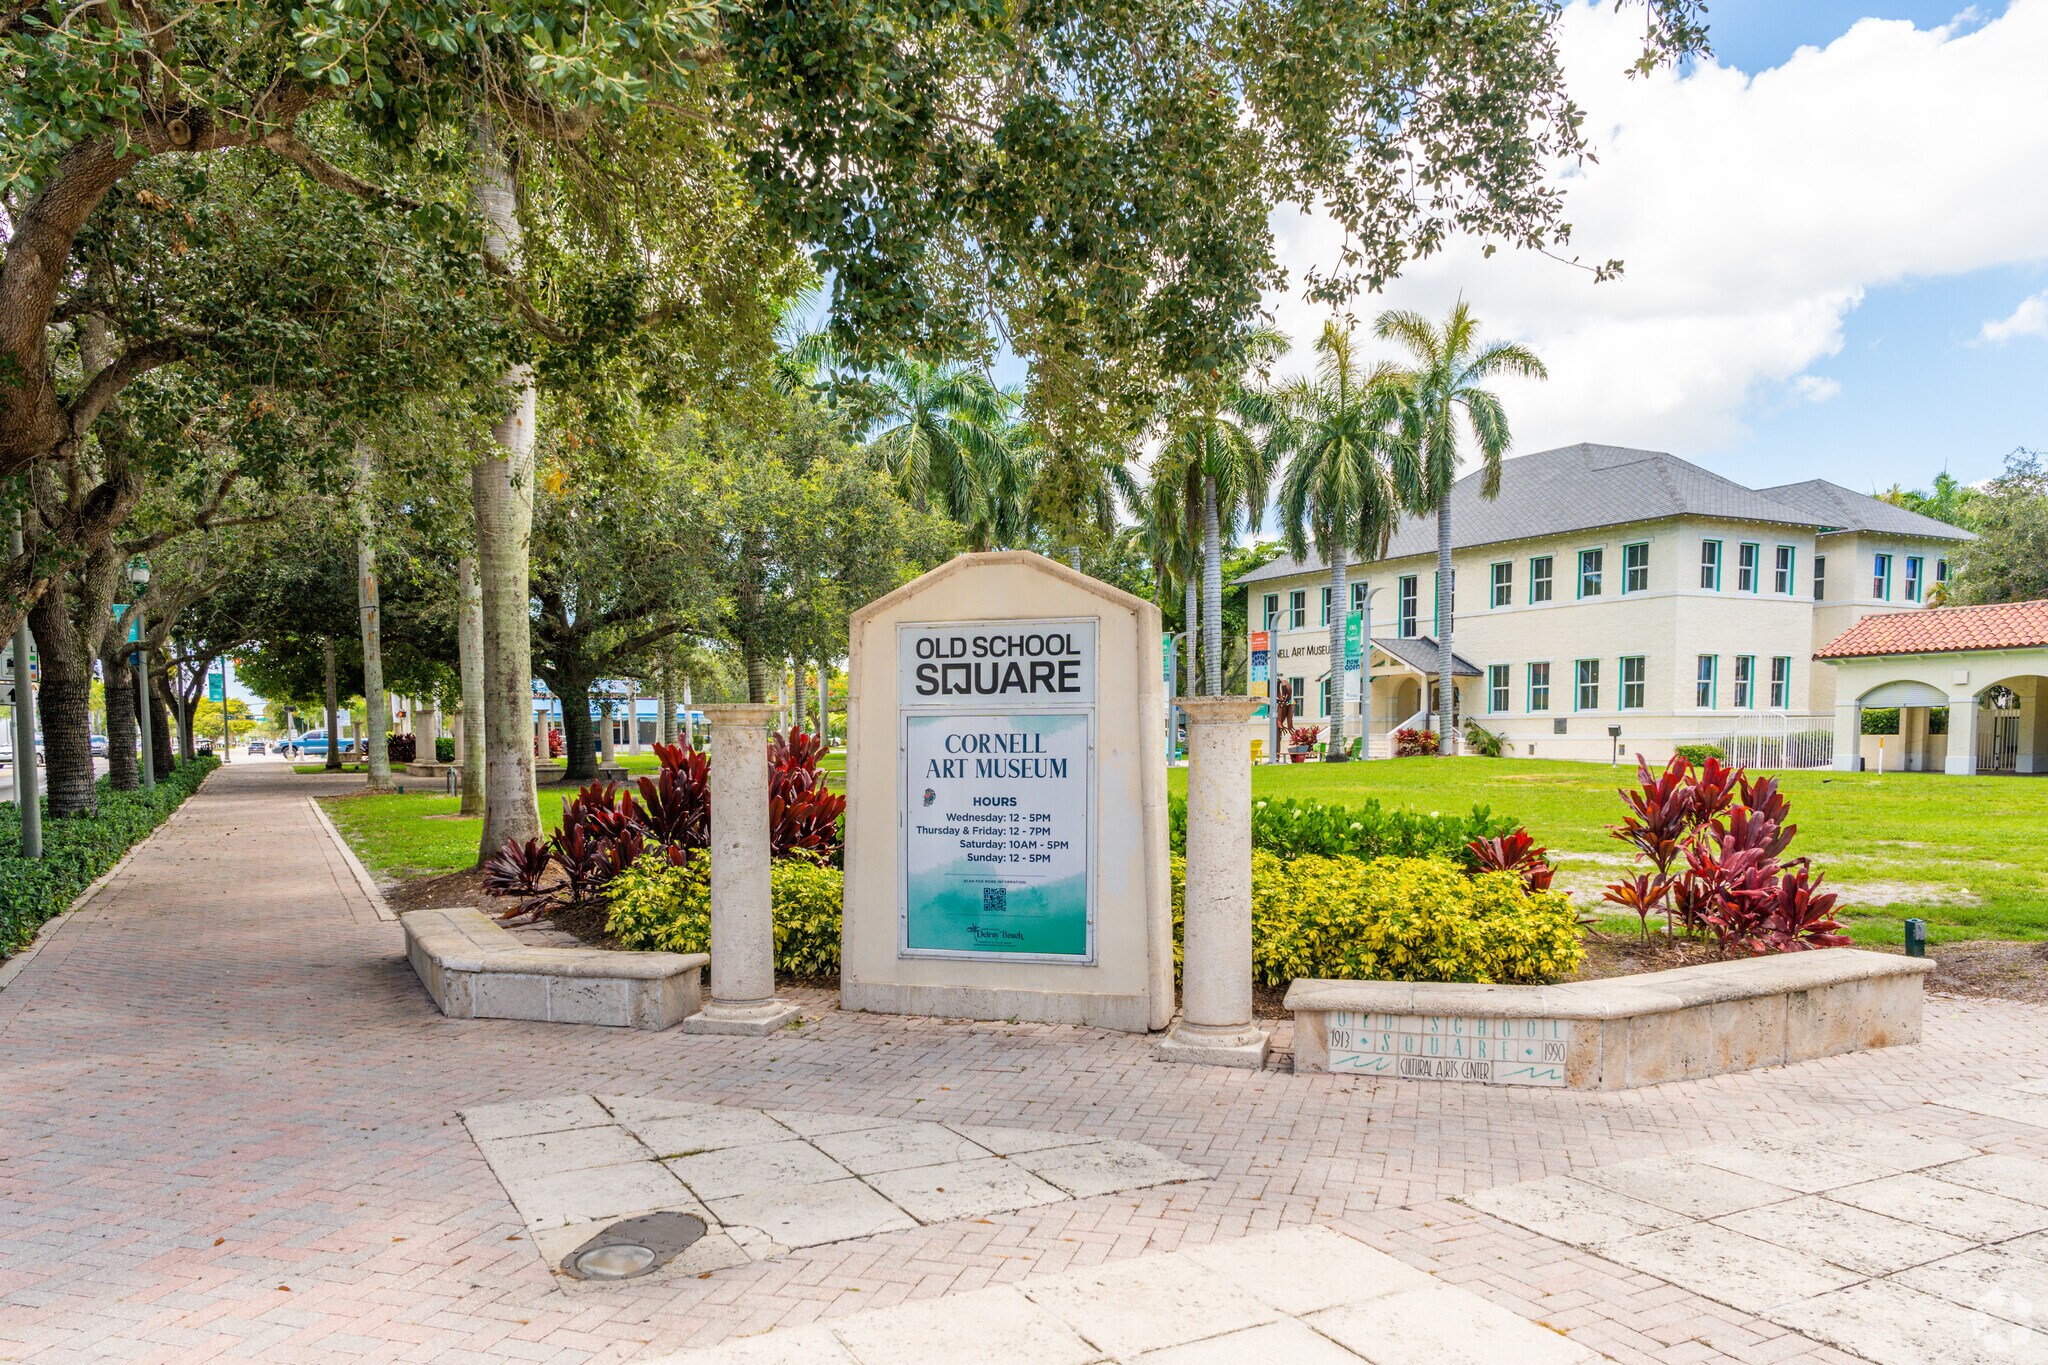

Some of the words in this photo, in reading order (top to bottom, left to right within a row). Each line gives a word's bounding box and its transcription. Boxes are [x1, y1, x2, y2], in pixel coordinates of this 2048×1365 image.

[915, 637, 967, 660] OLD
[972, 633, 1081, 658] SCHOOL
[1306, 644, 1331, 656] MUSEU
[1344, 664, 1361, 672] open
[915, 660, 1081, 696] SQUARE
[945, 733, 1047, 754] CORNELL
[926, 758, 969, 778] ART
[975, 758, 1068, 778] MUSEUM
[973, 797, 1018, 807] HOURS
[946, 813, 1007, 823] Wednesday:
[1009, 813, 1020, 822] 12
[1029, 813, 1051, 822] 5PM
[916, 826, 960, 836] Thursday
[963, 826, 970, 835] &
[972, 826, 1007, 836] Friday:
[1009, 827, 1020, 835] 12
[1029, 827, 1051, 836] 7PM
[959, 839, 1007, 850] Saturday:
[1009, 840, 1037, 849] 10AM
[1047, 840, 1069, 849] 5PM
[967, 853, 1007, 863] Sunday:
[1009, 854, 1020, 862] 12
[1029, 854, 1051, 863] 5PM
[976, 930, 999, 940] Delray
[1000, 930, 1025, 940] Beach
[1431, 1015, 1560, 1039] SCHOOL
[1331, 1029, 1350, 1049] 1913
[1544, 1043, 1566, 1062] 1990
[1400, 1058, 1433, 1077] CULTURAL
[1435, 1060, 1459, 1078] ARTS
[1461, 1060, 1490, 1080] CENTER
